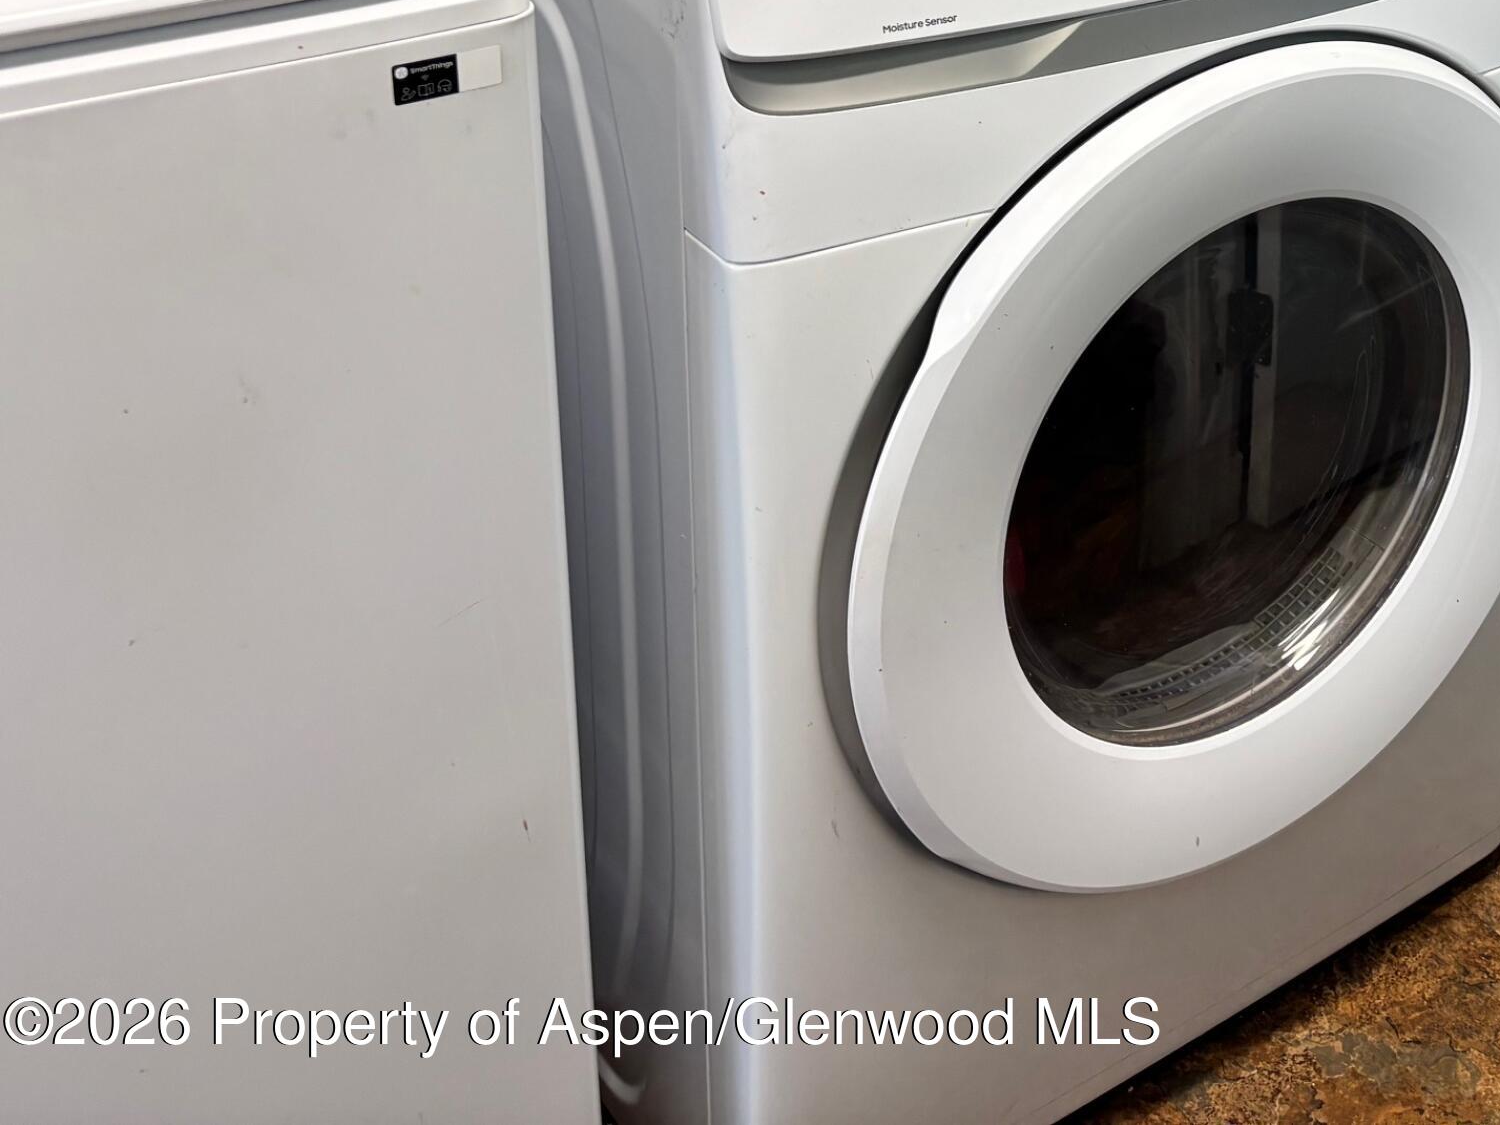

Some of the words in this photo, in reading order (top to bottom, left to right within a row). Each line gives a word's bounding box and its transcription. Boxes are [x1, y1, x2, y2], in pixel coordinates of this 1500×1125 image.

[882, 19, 924, 34] Moisture
[925, 14, 957, 27] Sensor
[409, 61, 454, 75] SmartThings
